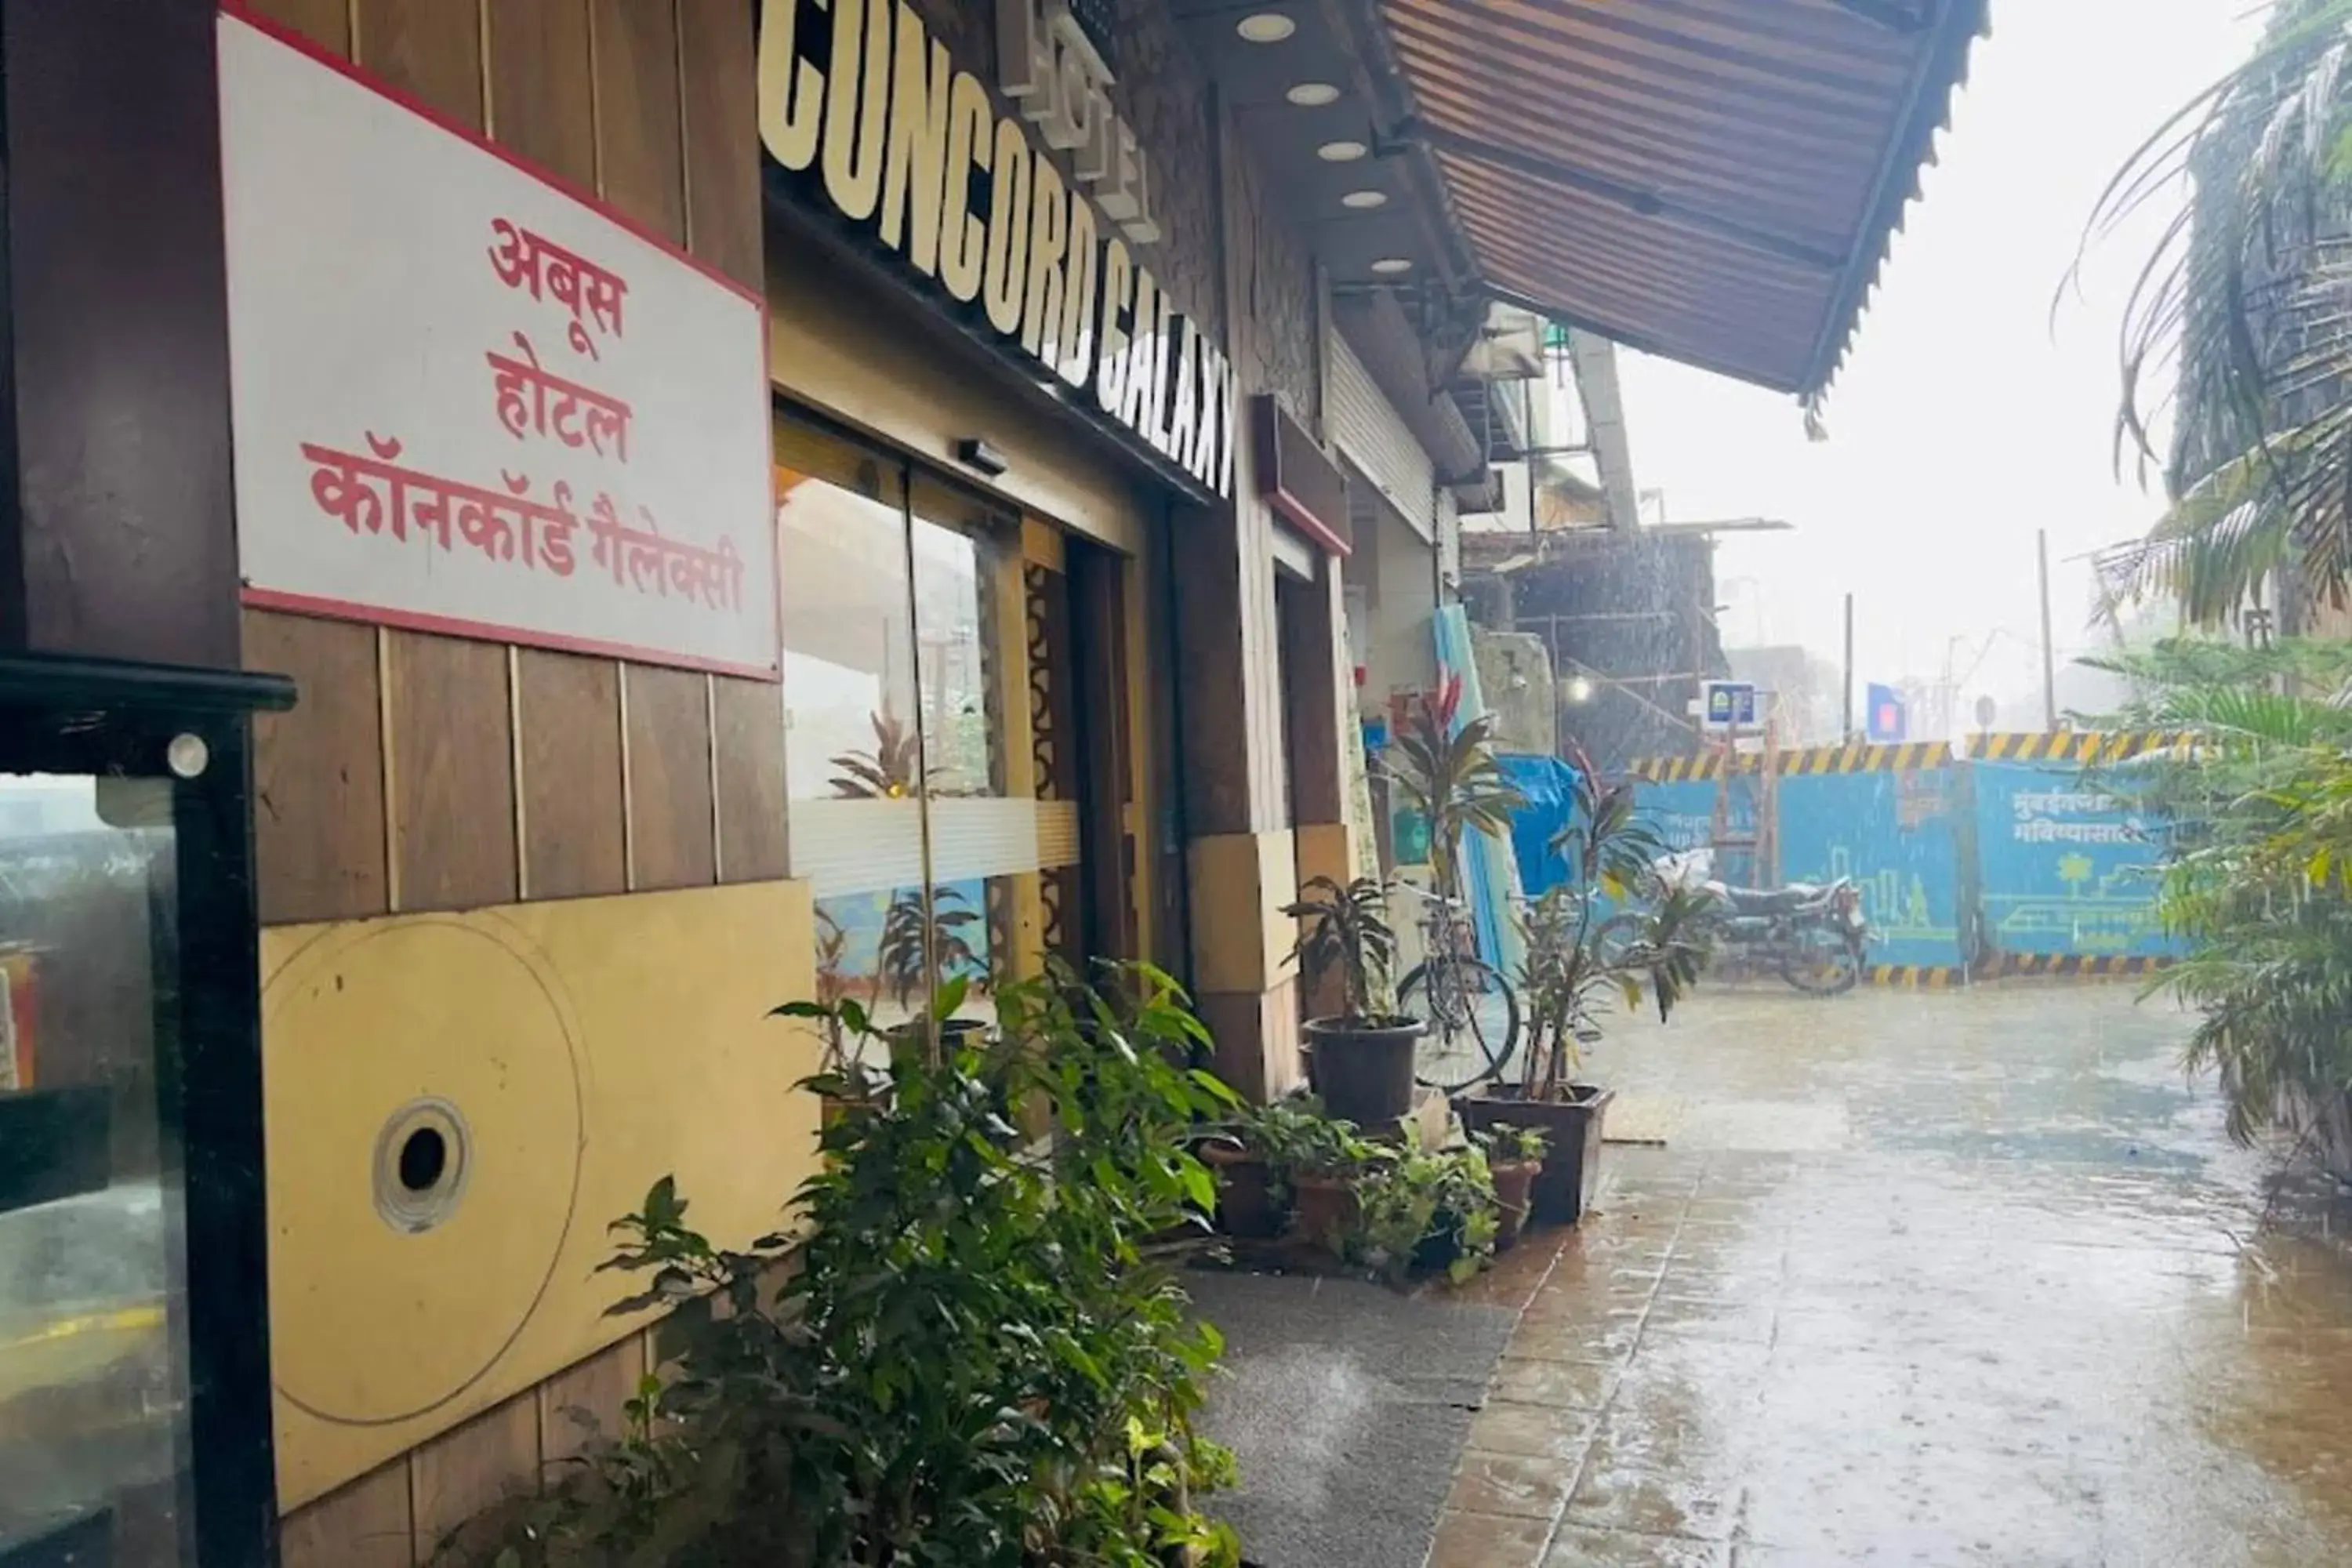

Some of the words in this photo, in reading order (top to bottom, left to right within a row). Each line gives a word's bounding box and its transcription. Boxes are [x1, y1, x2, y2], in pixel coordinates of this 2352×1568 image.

[488, 217, 628, 361] अबूस
[486, 332, 633, 464] होटल
[1098, 238, 1240, 500] GALAXY
[300, 431, 581, 577] कॉनकॉर्ड
